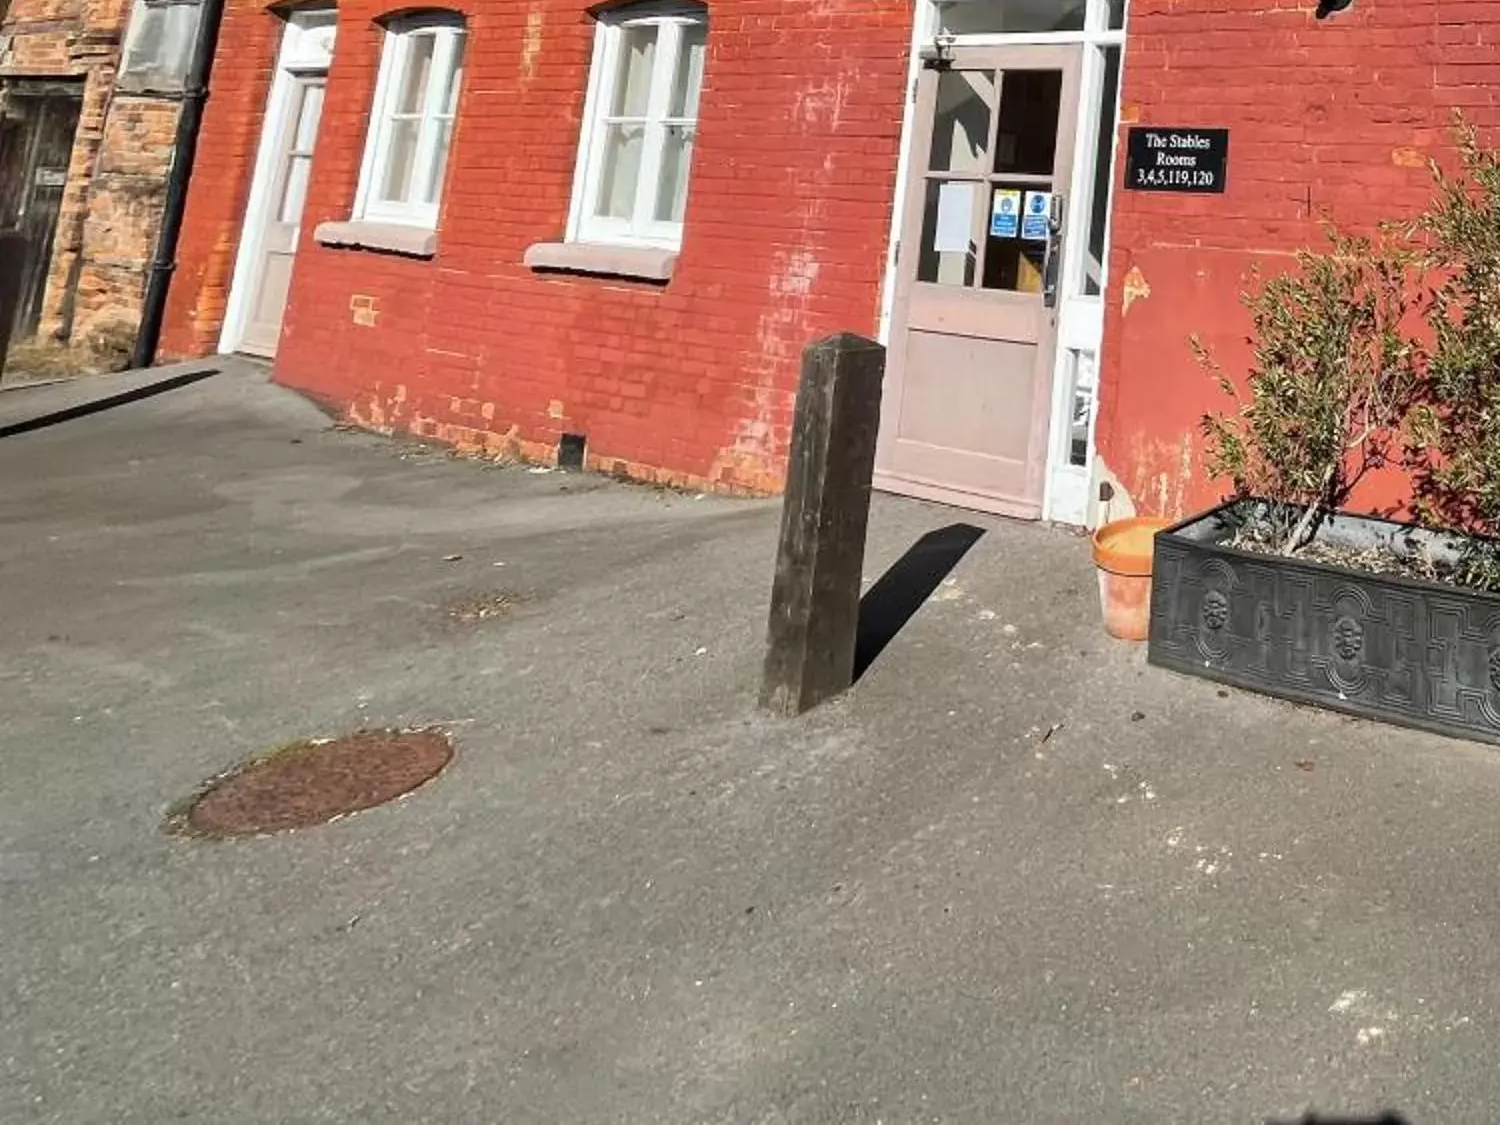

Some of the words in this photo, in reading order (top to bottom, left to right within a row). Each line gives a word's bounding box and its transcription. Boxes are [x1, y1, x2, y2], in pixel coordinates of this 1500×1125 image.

[1146, 133, 1168, 148] The
[1169, 134, 1211, 150] Stables
[1156, 151, 1197, 167] Rooms
